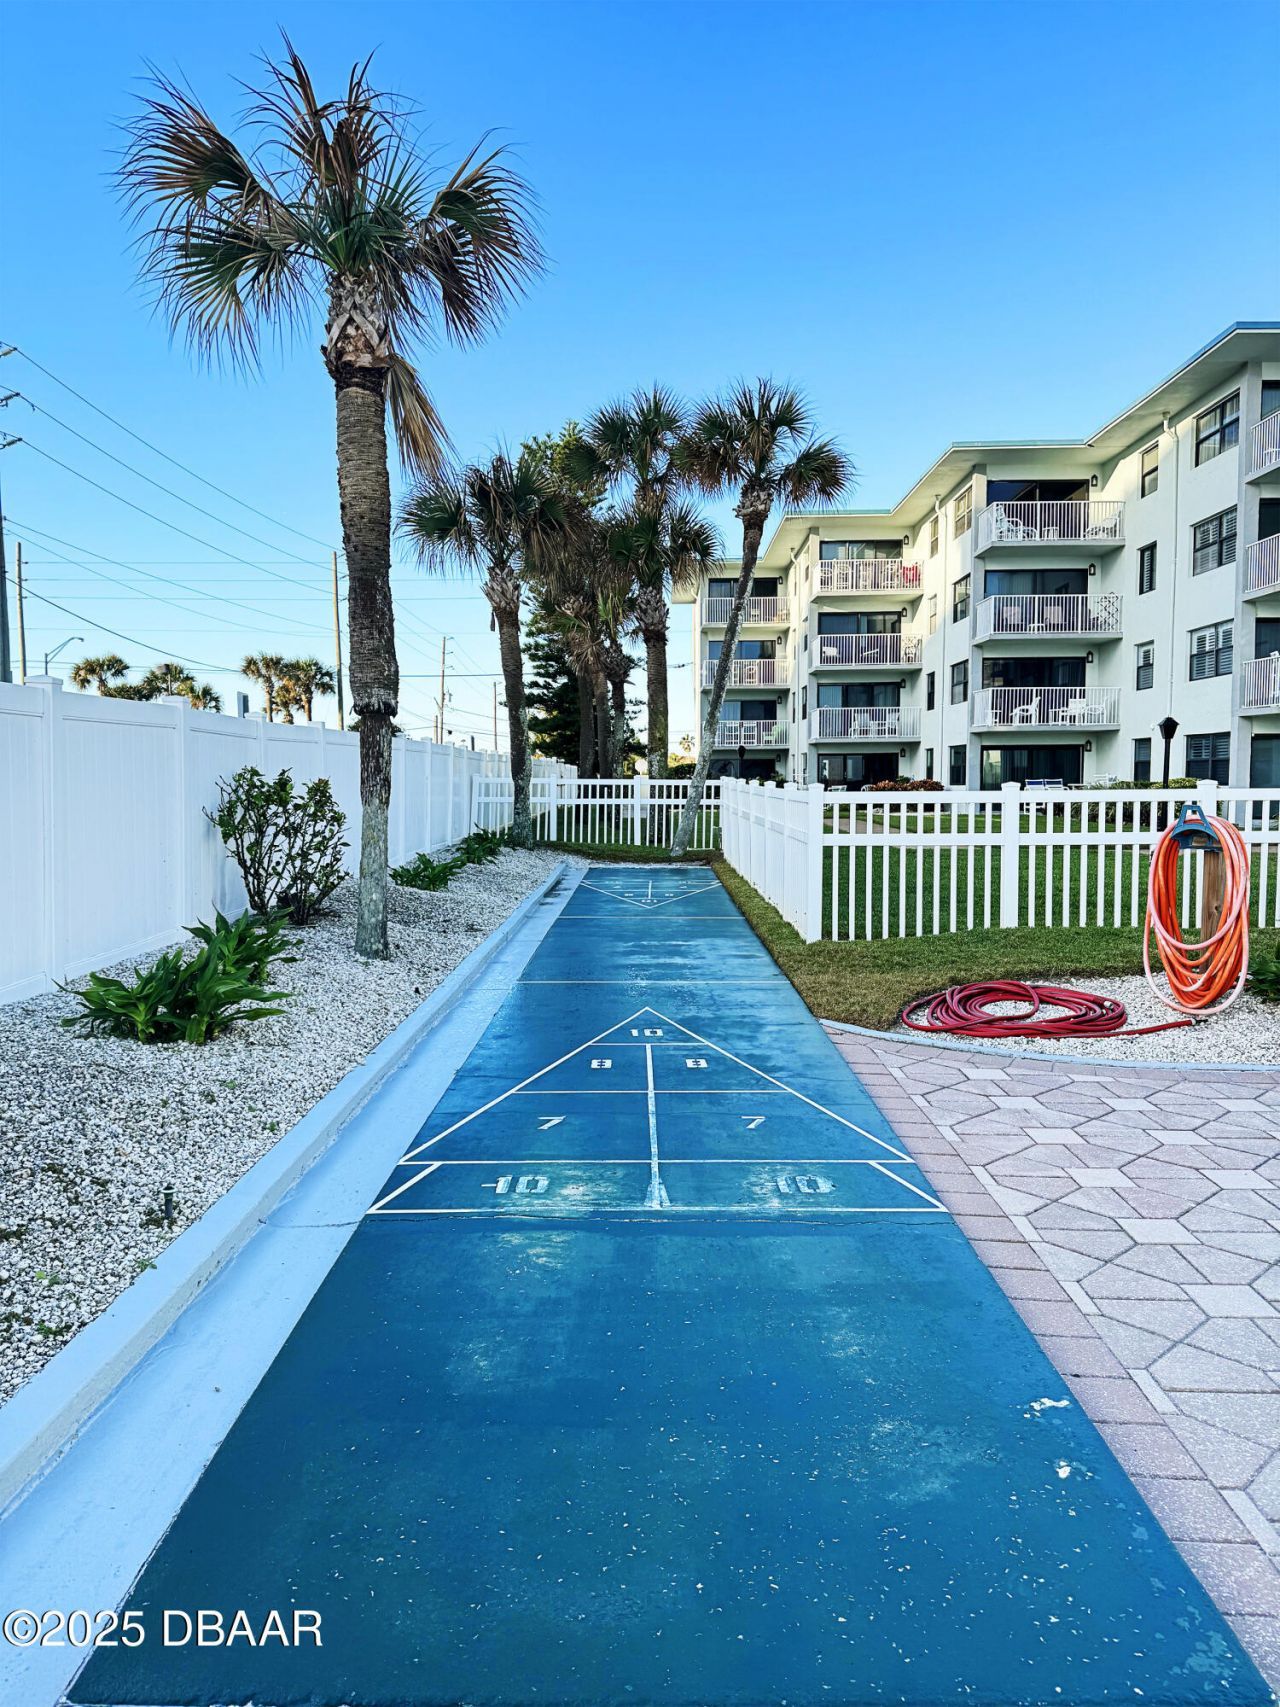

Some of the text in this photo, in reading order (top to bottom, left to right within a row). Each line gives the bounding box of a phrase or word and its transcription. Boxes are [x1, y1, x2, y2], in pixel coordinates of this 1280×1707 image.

[630, 1028, 664, 1037] 10
[591, 1059, 613, 1069] 8
[685, 1058, 708, 1068] 8
[537, 1116, 567, 1130] 7
[741, 1116, 766, 1129] 7
